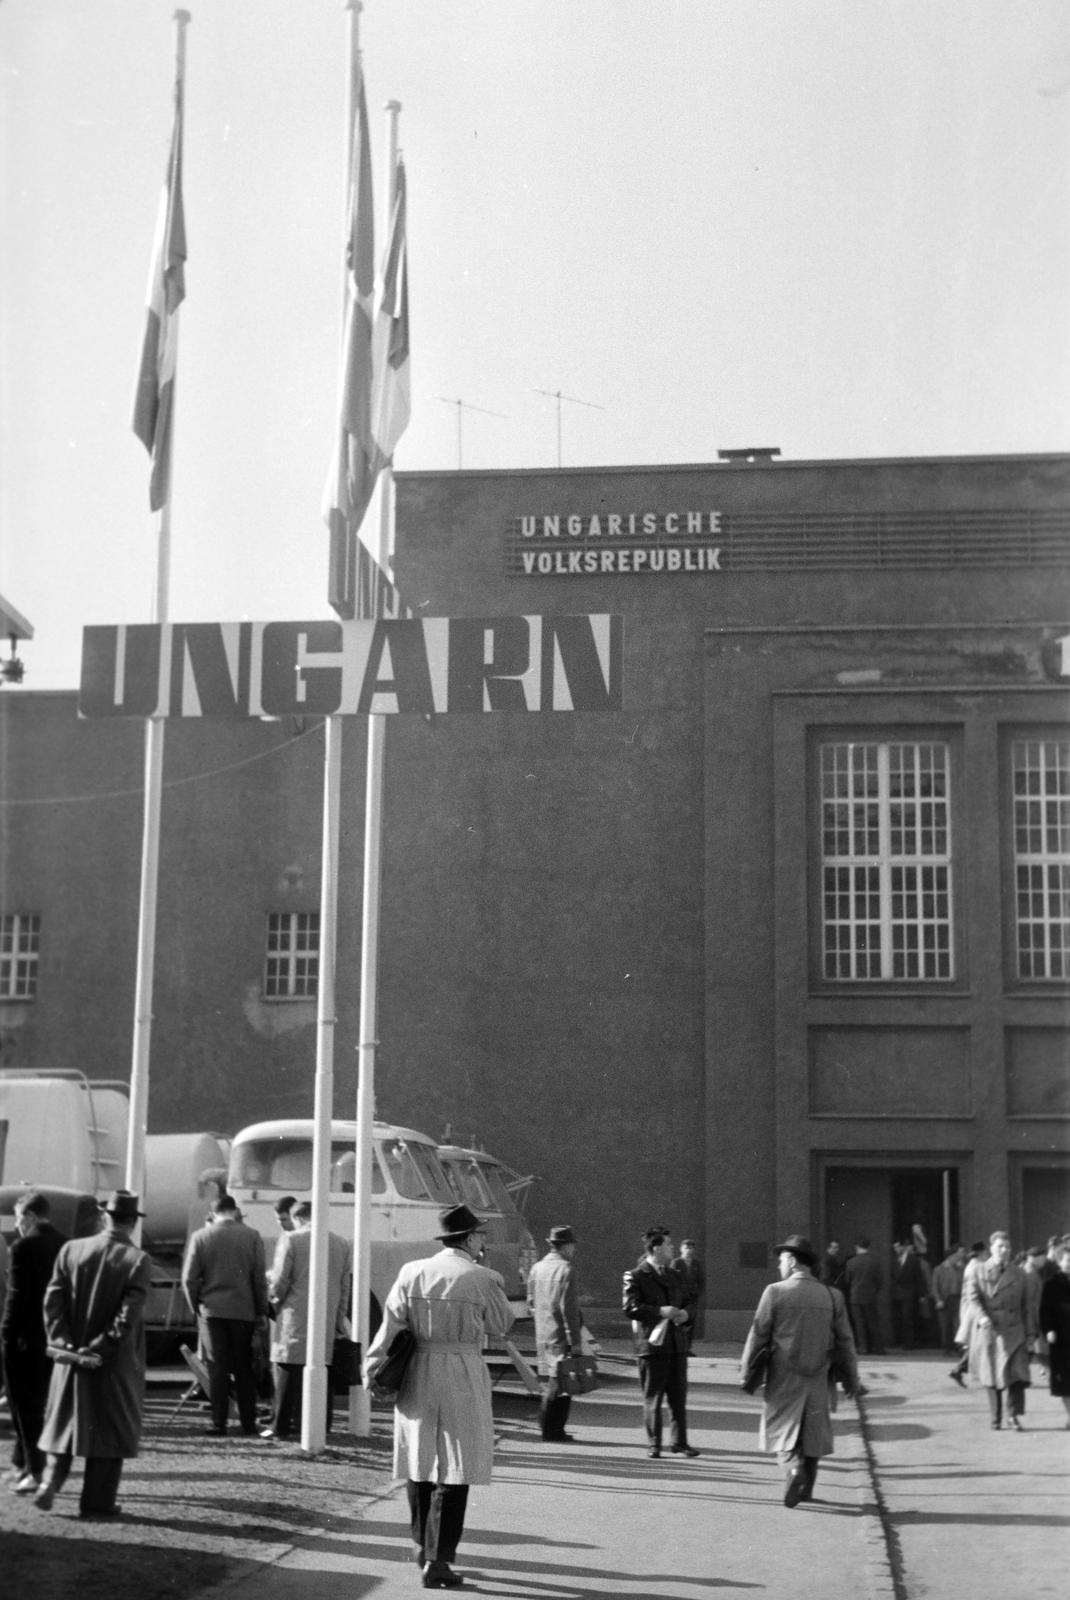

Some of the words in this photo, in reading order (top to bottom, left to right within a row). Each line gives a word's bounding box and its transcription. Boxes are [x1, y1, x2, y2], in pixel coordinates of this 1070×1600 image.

[521, 511, 722, 537] UNGARISCHE
[522, 548, 721, 574] VOLKSREPUBLIK
[79, 615, 622, 718] UNGARN
